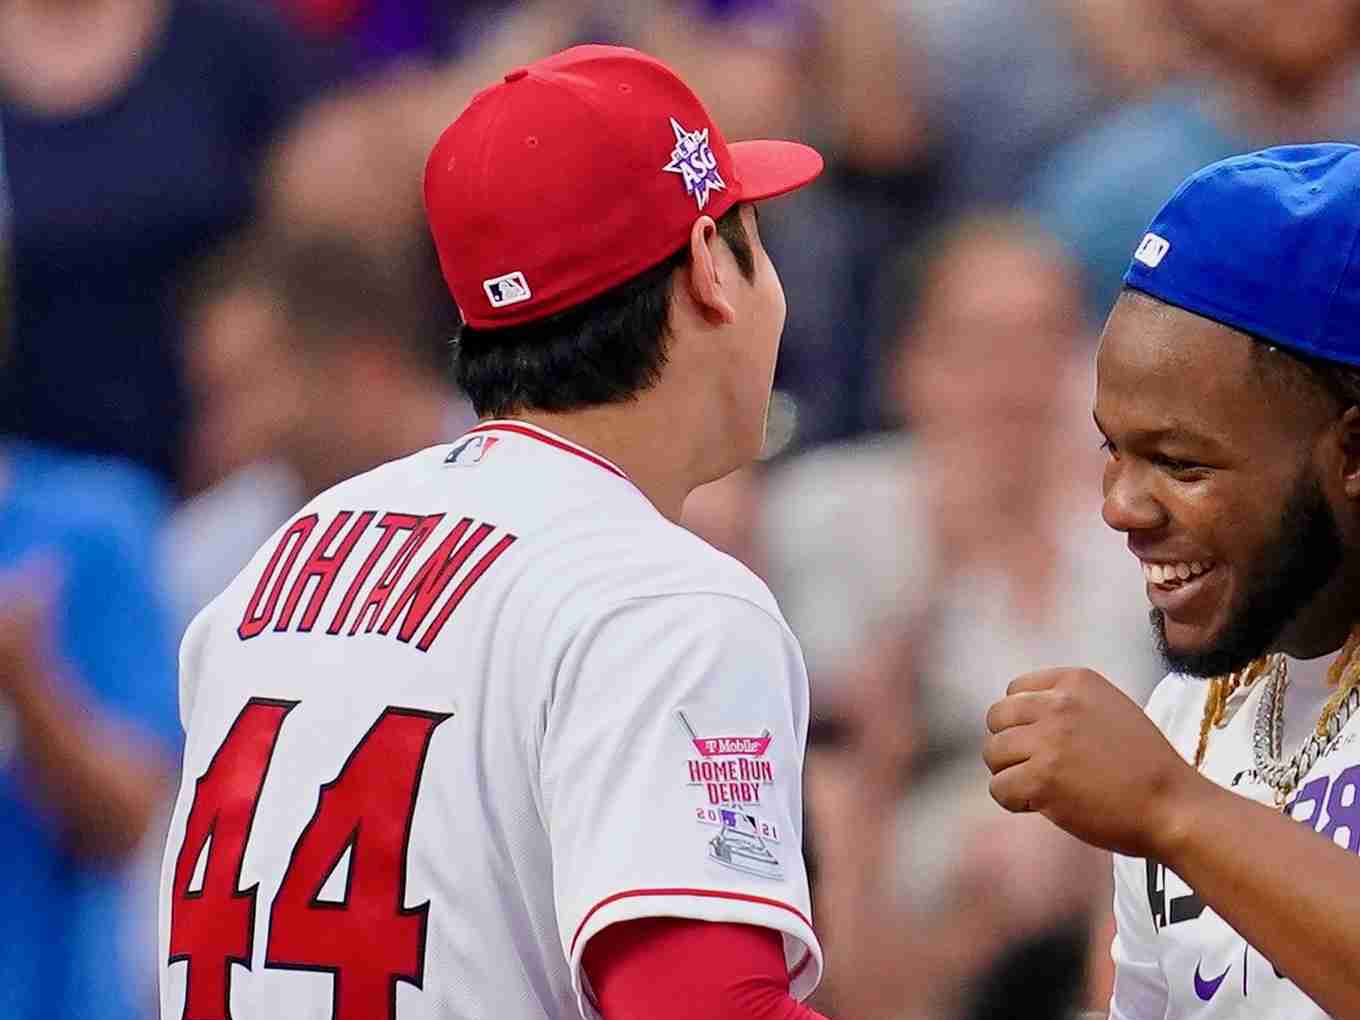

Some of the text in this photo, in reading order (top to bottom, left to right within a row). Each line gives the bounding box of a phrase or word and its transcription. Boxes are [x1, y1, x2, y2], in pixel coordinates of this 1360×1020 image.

[680, 142, 716, 196] ASG
[237, 510, 518, 653] OHTANI
[706, 782, 761, 805] DERBY
